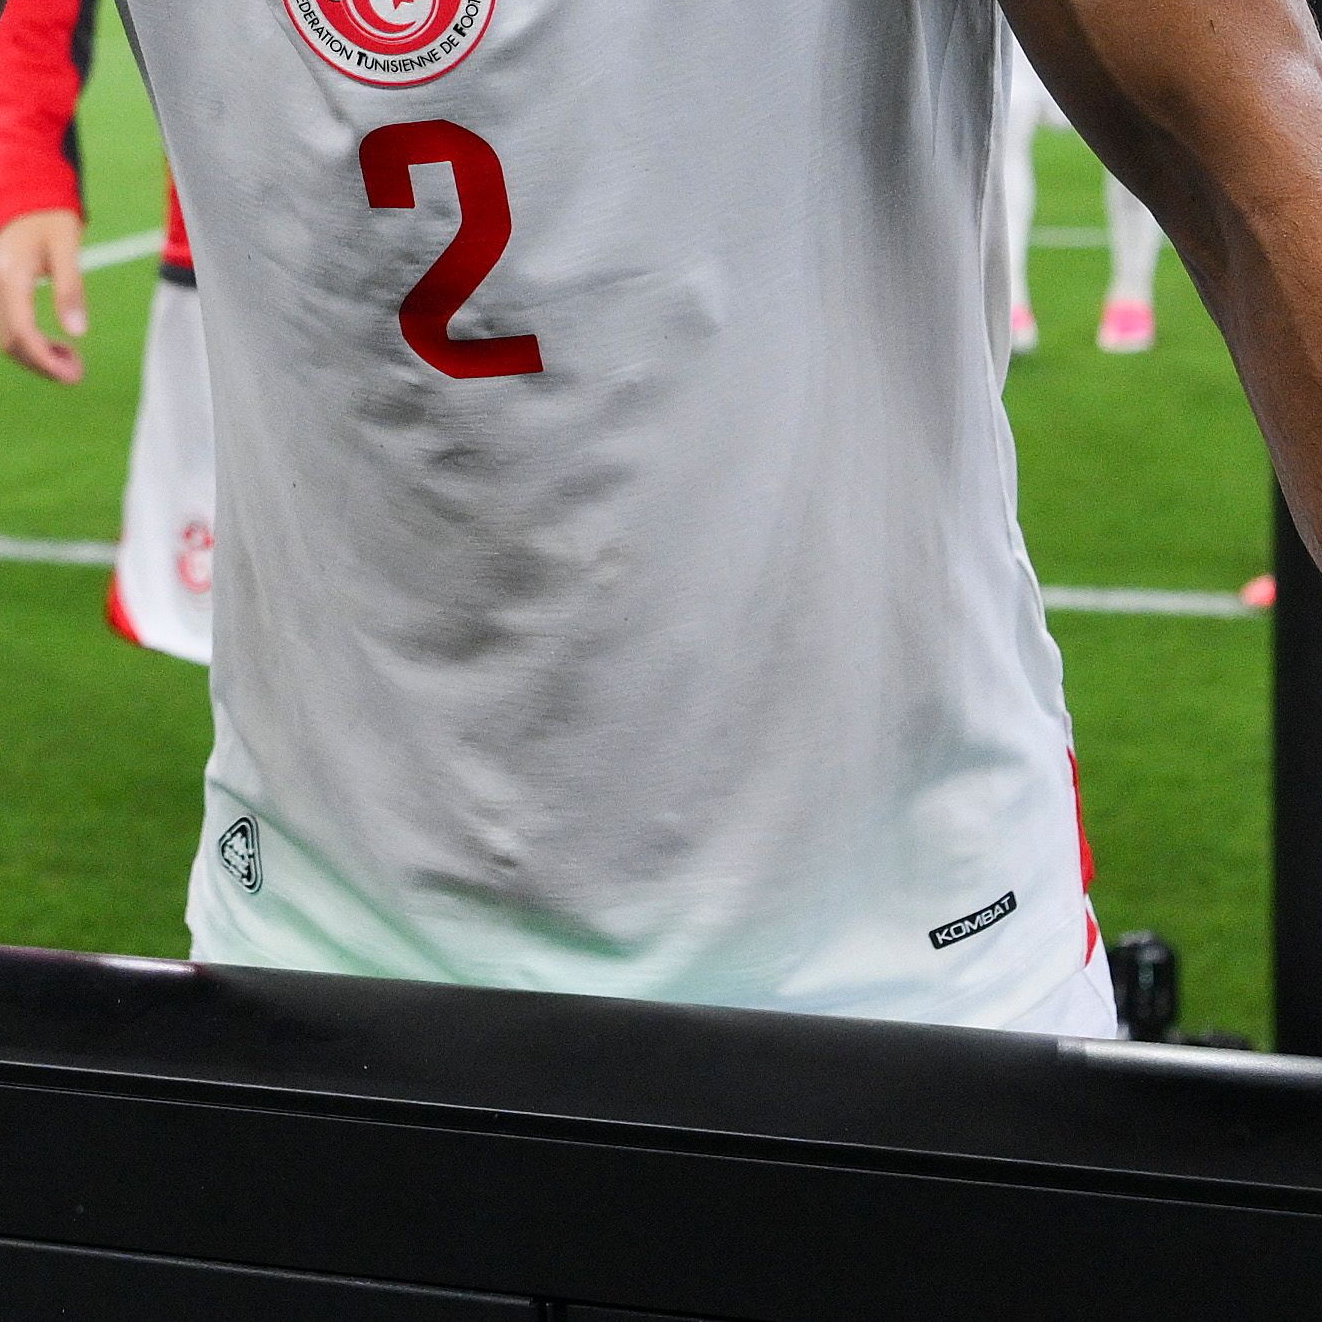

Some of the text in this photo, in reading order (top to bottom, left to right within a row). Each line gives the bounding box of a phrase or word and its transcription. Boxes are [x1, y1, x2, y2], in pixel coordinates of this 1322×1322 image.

[356, 51, 442, 73] TUNISIENNE
[440, 35, 460, 54] DE
[359, 118, 544, 379] 2
[935, 896, 1011, 945] KOMBAT
